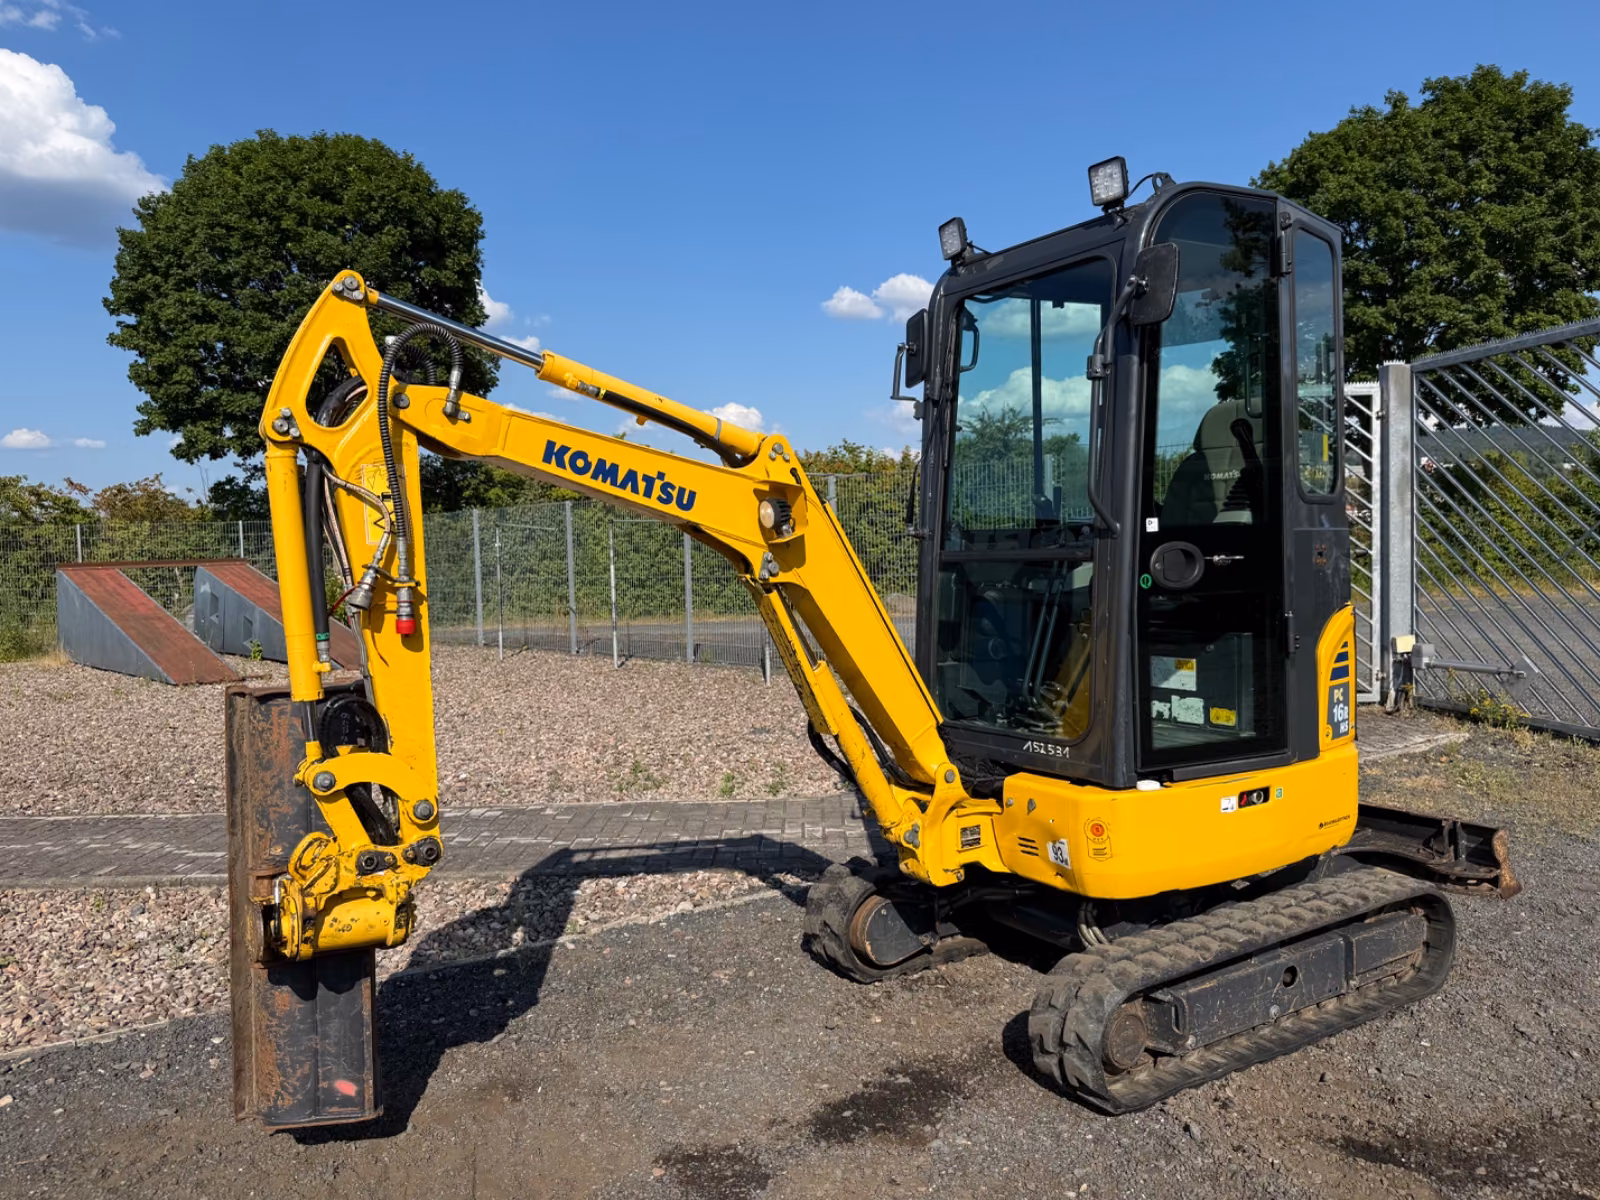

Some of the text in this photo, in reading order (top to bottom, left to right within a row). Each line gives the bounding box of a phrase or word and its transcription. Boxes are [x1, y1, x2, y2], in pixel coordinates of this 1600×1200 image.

[542, 439, 697, 512] KOMATSU
[1203, 469, 1242, 481] KOMATS
[1333, 687, 1344, 703] PC
[1052, 845, 1064, 864] 93
